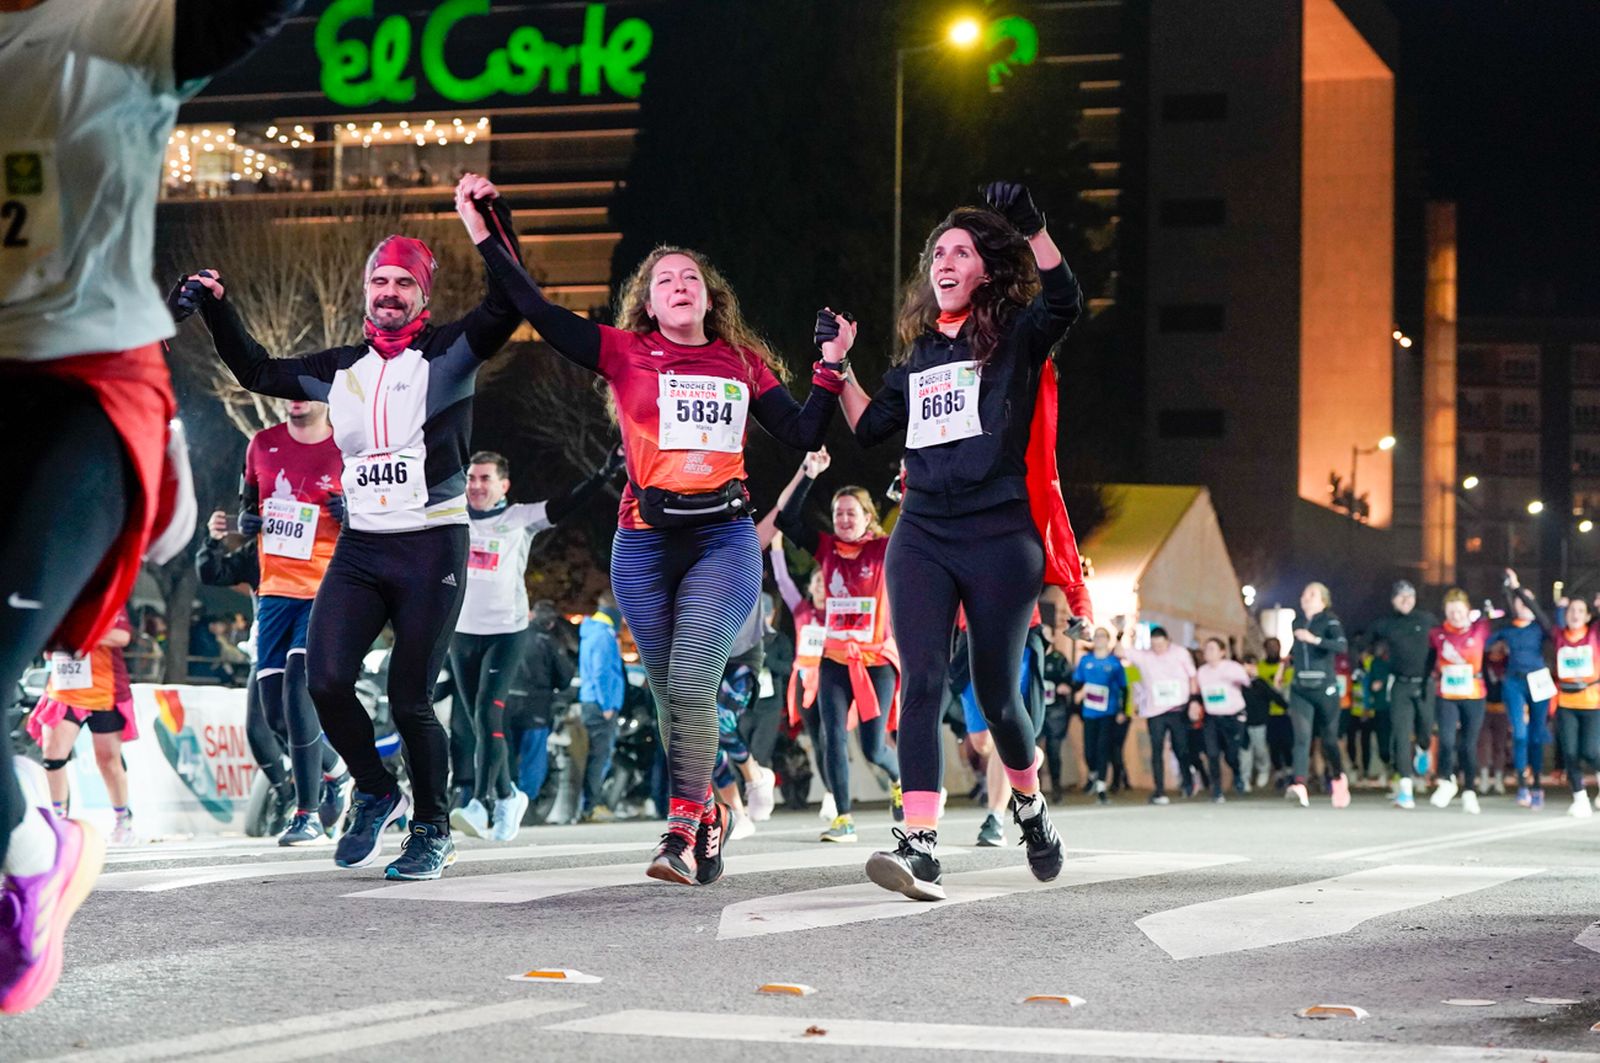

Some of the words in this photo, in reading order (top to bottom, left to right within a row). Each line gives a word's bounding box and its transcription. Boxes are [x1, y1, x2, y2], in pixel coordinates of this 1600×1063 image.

[314, 0, 416, 106] El
[421, 0, 653, 102] Corte
[707, 383, 716, 391] DE
[925, 374, 943, 385] NOCHE
[670, 390, 687, 398] SAN
[689, 390, 717, 399] ANTON
[918, 387, 930, 398] SAN
[677, 399, 732, 425] 5834
[922, 389, 965, 420] 6685
[356, 462, 407, 487] 3446
[266, 518, 304, 539] 3908
[204, 724, 245, 758] SAN
